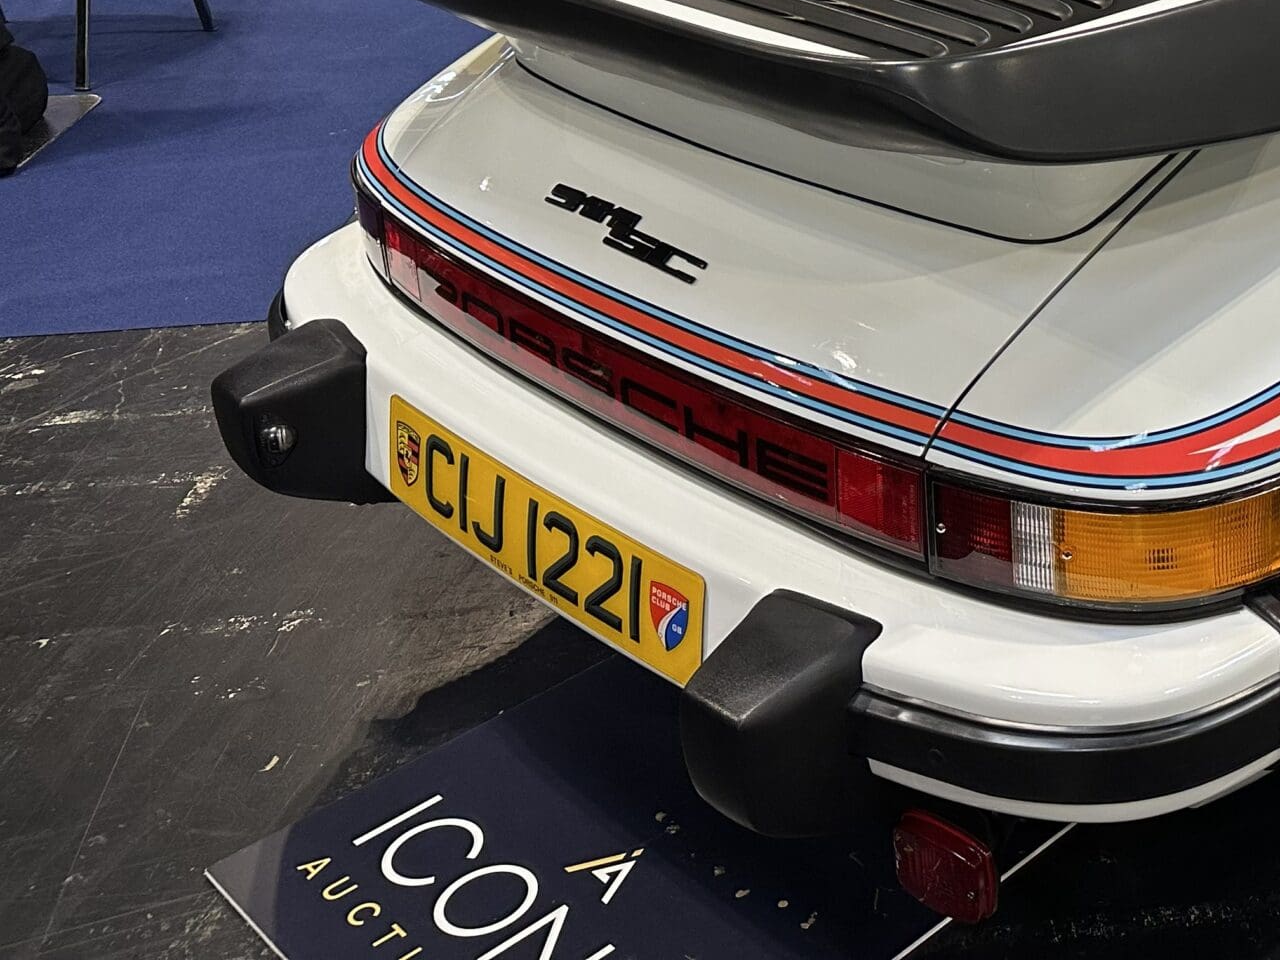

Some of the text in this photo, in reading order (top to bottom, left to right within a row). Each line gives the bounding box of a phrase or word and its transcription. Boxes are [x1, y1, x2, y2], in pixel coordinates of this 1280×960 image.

[417, 262, 829, 504] PORSCHE
[425, 433, 643, 644] CIJ 1221
[518, 573, 546, 598] PORSCHE
[651, 585, 688, 612] PORSCHE
[651, 596, 671, 612] CLUB
[671, 622, 683, 636] GB
